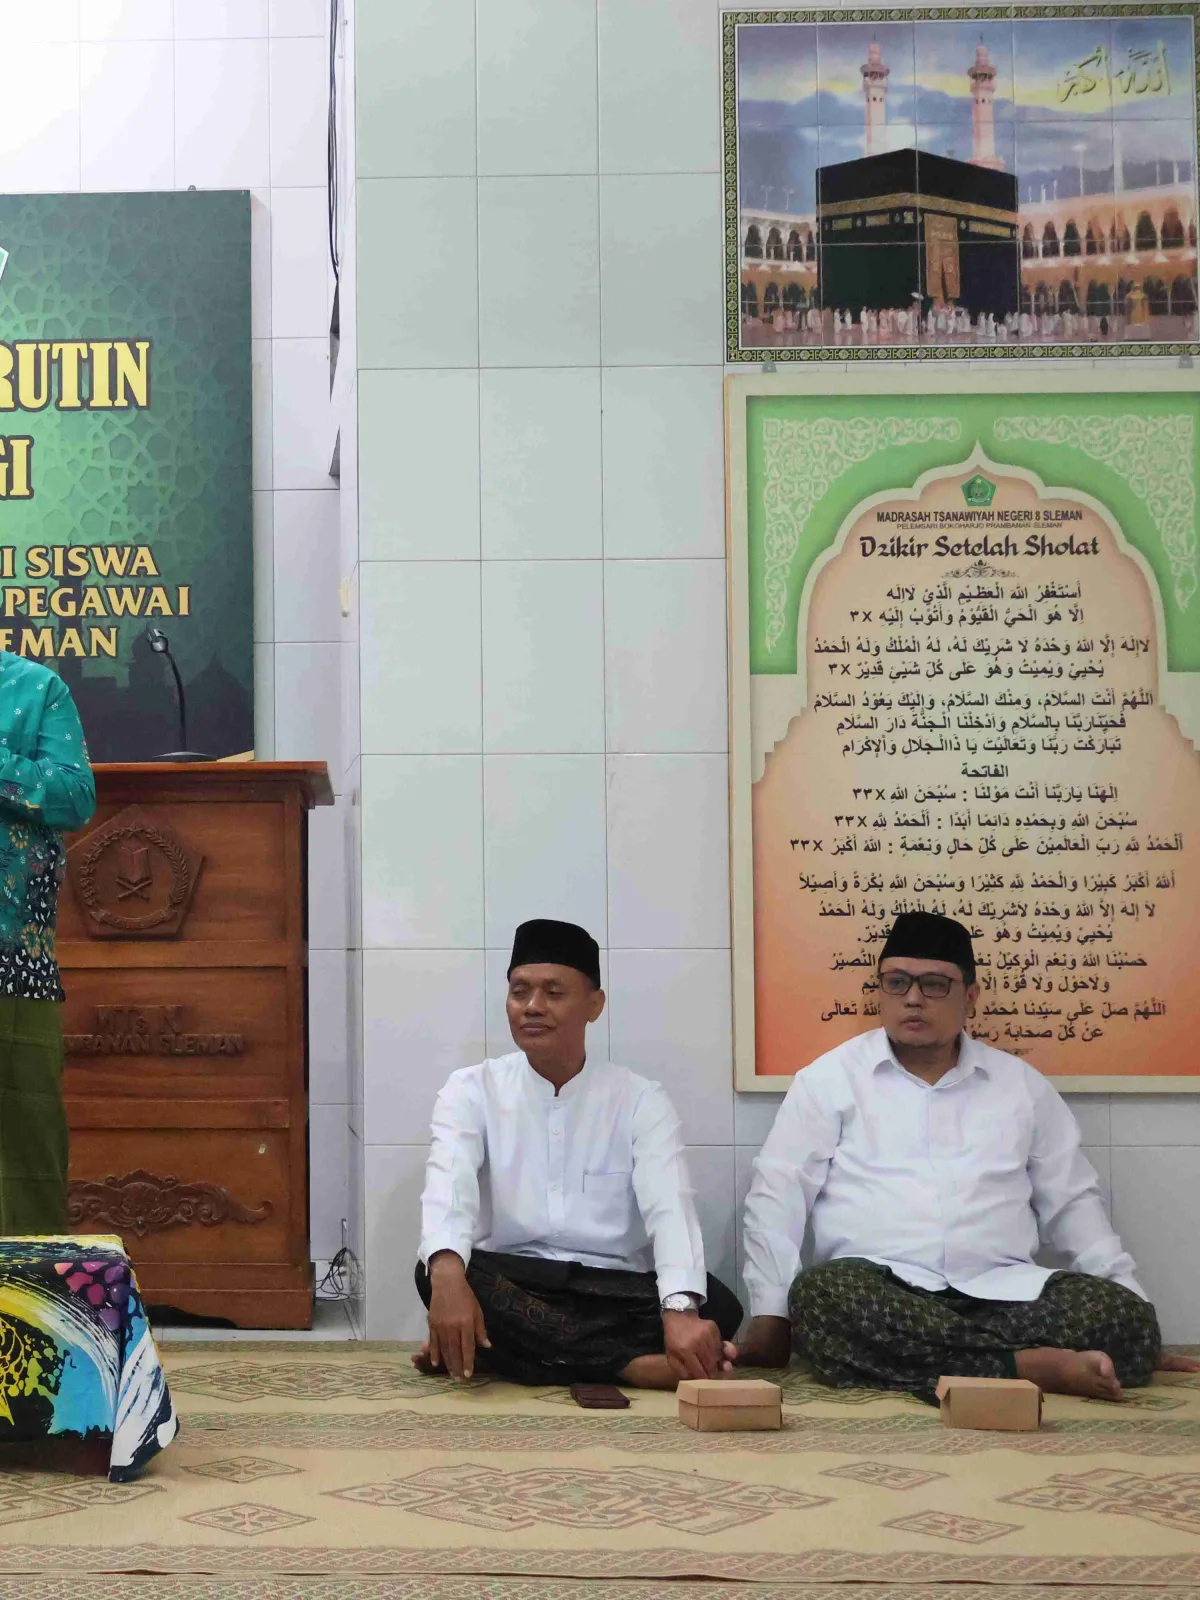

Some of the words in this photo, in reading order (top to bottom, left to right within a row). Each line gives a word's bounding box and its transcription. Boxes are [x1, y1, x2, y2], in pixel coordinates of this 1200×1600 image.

[876, 511, 931, 523] MADRASAH
[934, 510, 994, 522] TSANAWIYAH
[997, 510, 1033, 522] NEGERI
[1043, 509, 1082, 521] SLEMAN
[859, 534, 929, 558] Dzikir
[932, 533, 1020, 558] Setelah
[1023, 532, 1100, 558] Sholat
[28, 547, 157, 577] SISWA
[5, 586, 189, 617] PEGAWAI
[961, 762, 1009, 778] الفاتحة
